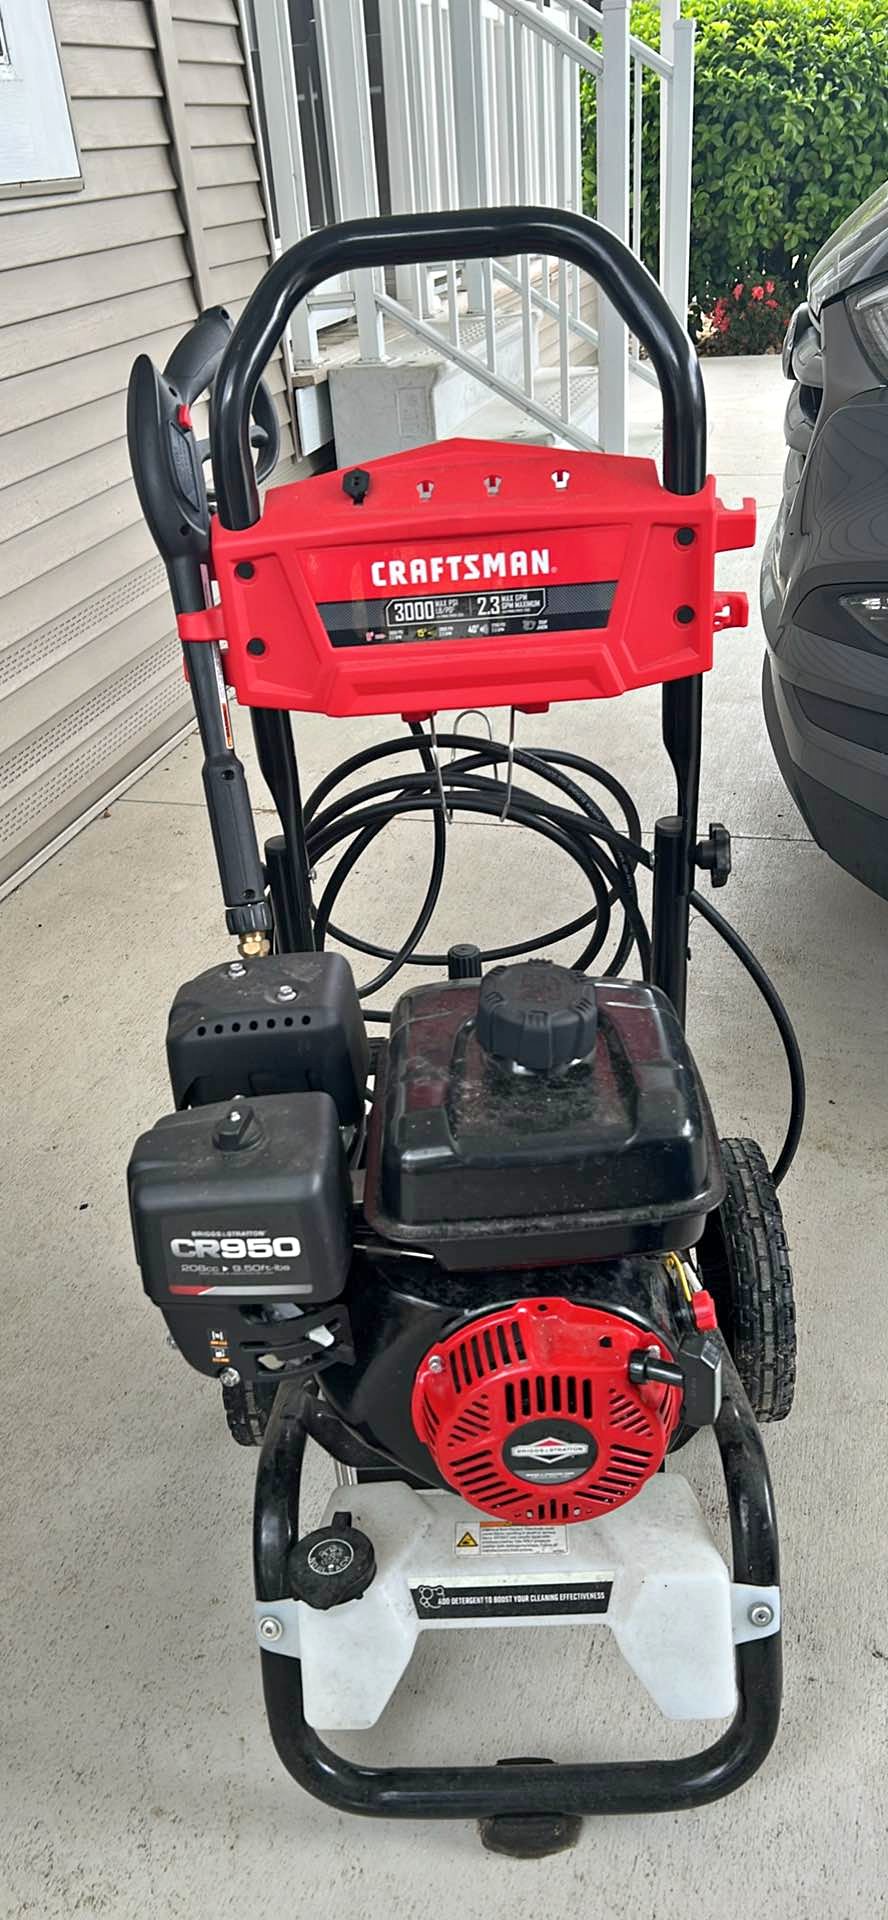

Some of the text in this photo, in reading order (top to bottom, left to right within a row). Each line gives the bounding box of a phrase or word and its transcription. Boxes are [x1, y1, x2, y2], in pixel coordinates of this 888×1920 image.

[371, 549, 550, 587] CRAFTSMAN
[394, 601, 435, 622] 3000
[477, 596, 500, 616] 2.3
[170, 1237, 301, 1258] CR950
[181, 1264, 219, 1272] 208cc
[438, 1592, 605, 1605] ADD DETERGENT TO BOOST YOUR CLEANING EFFECTIVENESS
